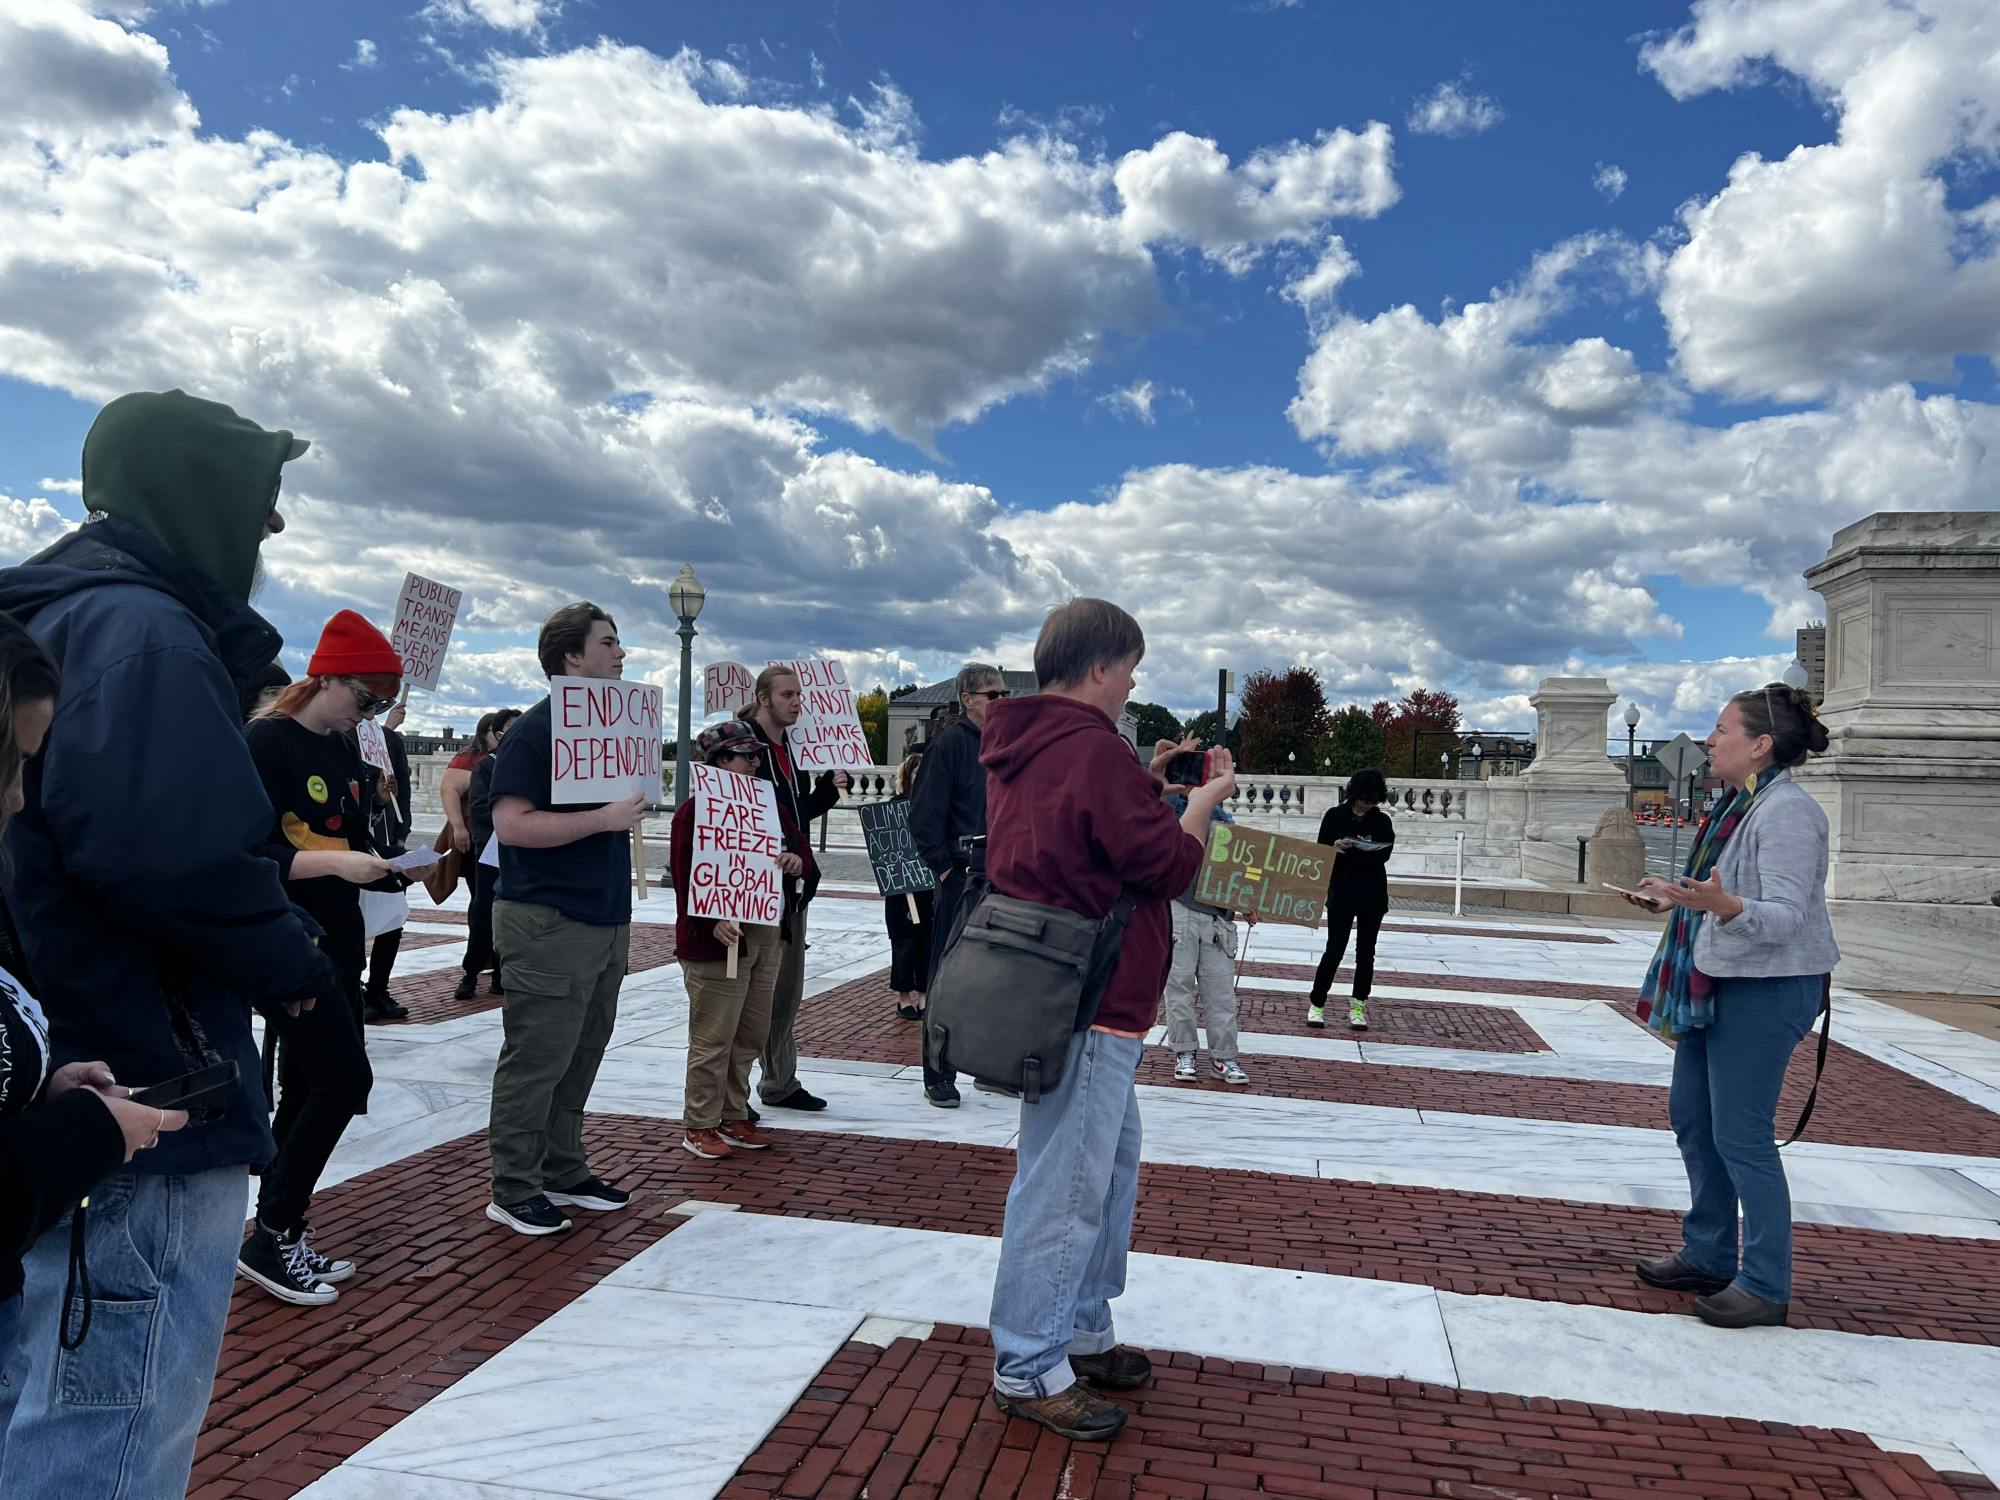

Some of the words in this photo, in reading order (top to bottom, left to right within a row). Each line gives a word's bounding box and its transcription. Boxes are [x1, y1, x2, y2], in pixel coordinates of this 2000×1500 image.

[409, 576, 459, 608] PUBLIC
[404, 597, 456, 629] TRANSIT
[396, 619, 447, 645] MEANS
[393, 635, 439, 662] EVERY
[402, 658, 434, 680] ODY
[707, 665, 751, 690] FUND
[563, 686, 623, 728] END
[628, 689, 660, 728] CAR
[706, 686, 754, 713] RIPT
[799, 689, 852, 718] RANSIT
[790, 723, 863, 745] CLIMATE
[799, 742, 873, 767] ACTION
[694, 763, 768, 808] R-LINE
[706, 797, 767, 833] FARE
[860, 800, 911, 832] CLIMAT
[697, 824, 779, 858] FREEZE
[889, 850, 908, 864] OR
[728, 852, 746, 869] IN
[1263, 836, 1325, 881] Lines
[693, 862, 780, 894] GLOBAL
[876, 859, 936, 892] DEATH
[691, 884, 779, 921] WARMING
[1258, 877, 1318, 922] Lines
